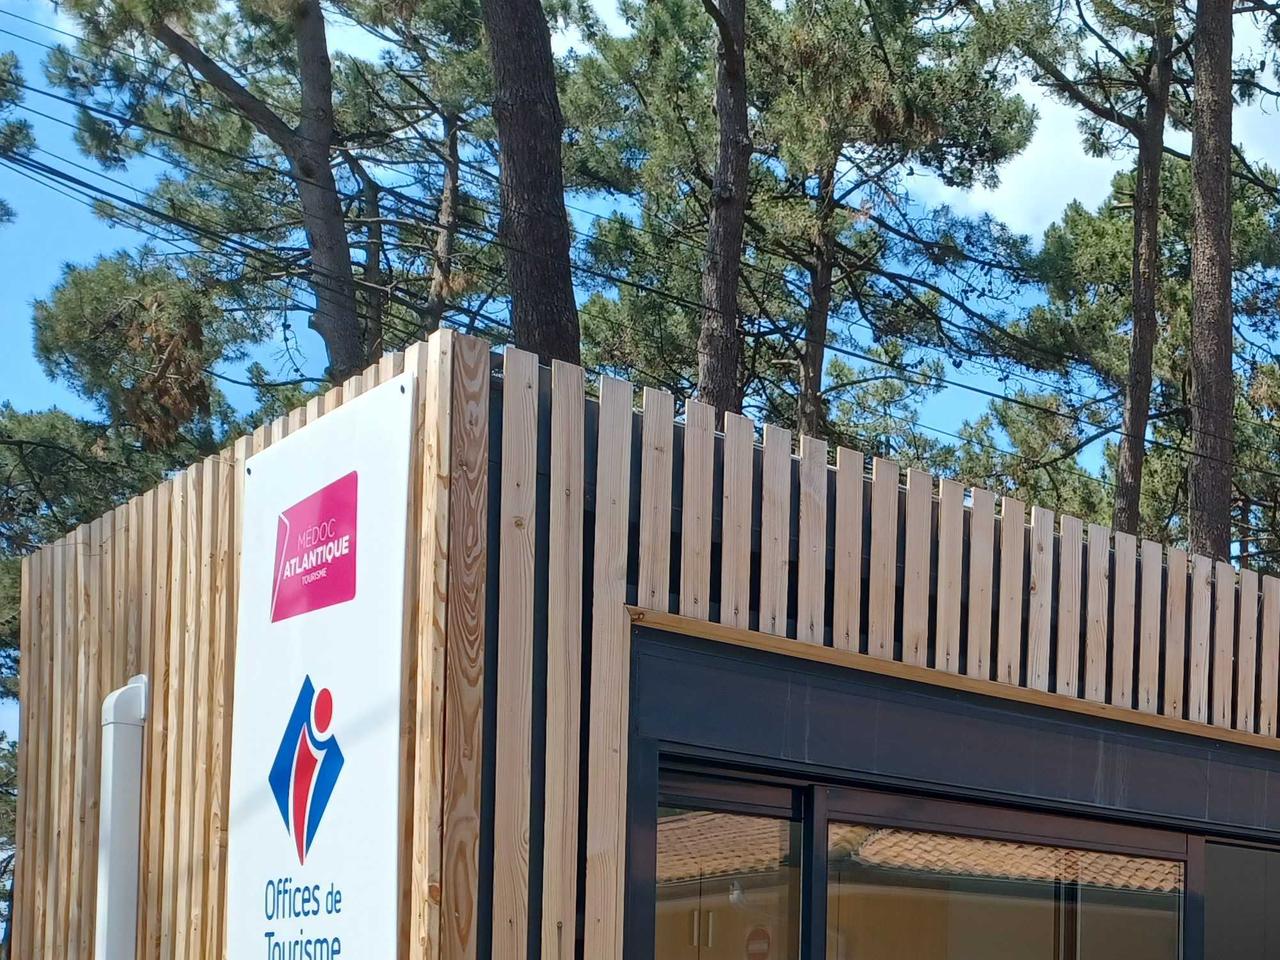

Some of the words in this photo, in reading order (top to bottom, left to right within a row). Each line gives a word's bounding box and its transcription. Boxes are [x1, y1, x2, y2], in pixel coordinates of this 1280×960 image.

[283, 534, 350, 580] ATLANTIQUE
[301, 567, 328, 586] TOURISME
[264, 877, 321, 921] Offices
[325, 882, 342, 915] de
